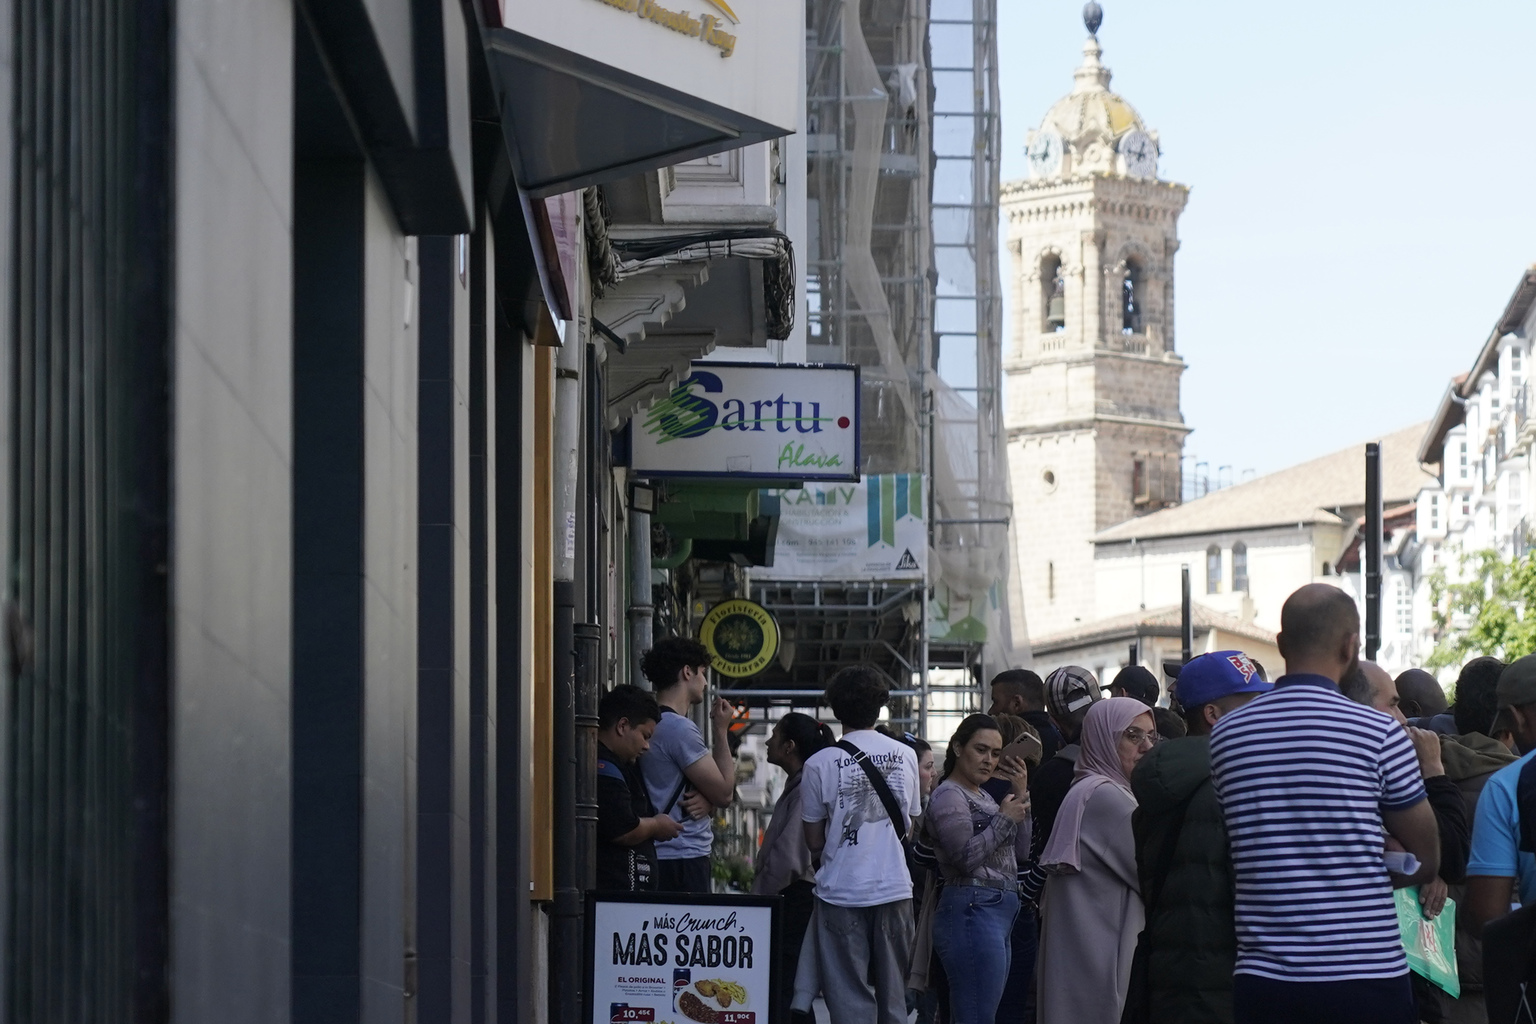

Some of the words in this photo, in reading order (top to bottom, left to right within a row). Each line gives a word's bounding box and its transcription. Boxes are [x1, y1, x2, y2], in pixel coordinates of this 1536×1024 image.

[660, 371, 823, 438] Sartu
[779, 440, 843, 469] Álava
[654, 913, 675, 930] MÁS
[612, 921, 668, 967] MÁS
[675, 934, 754, 969] SABOR
